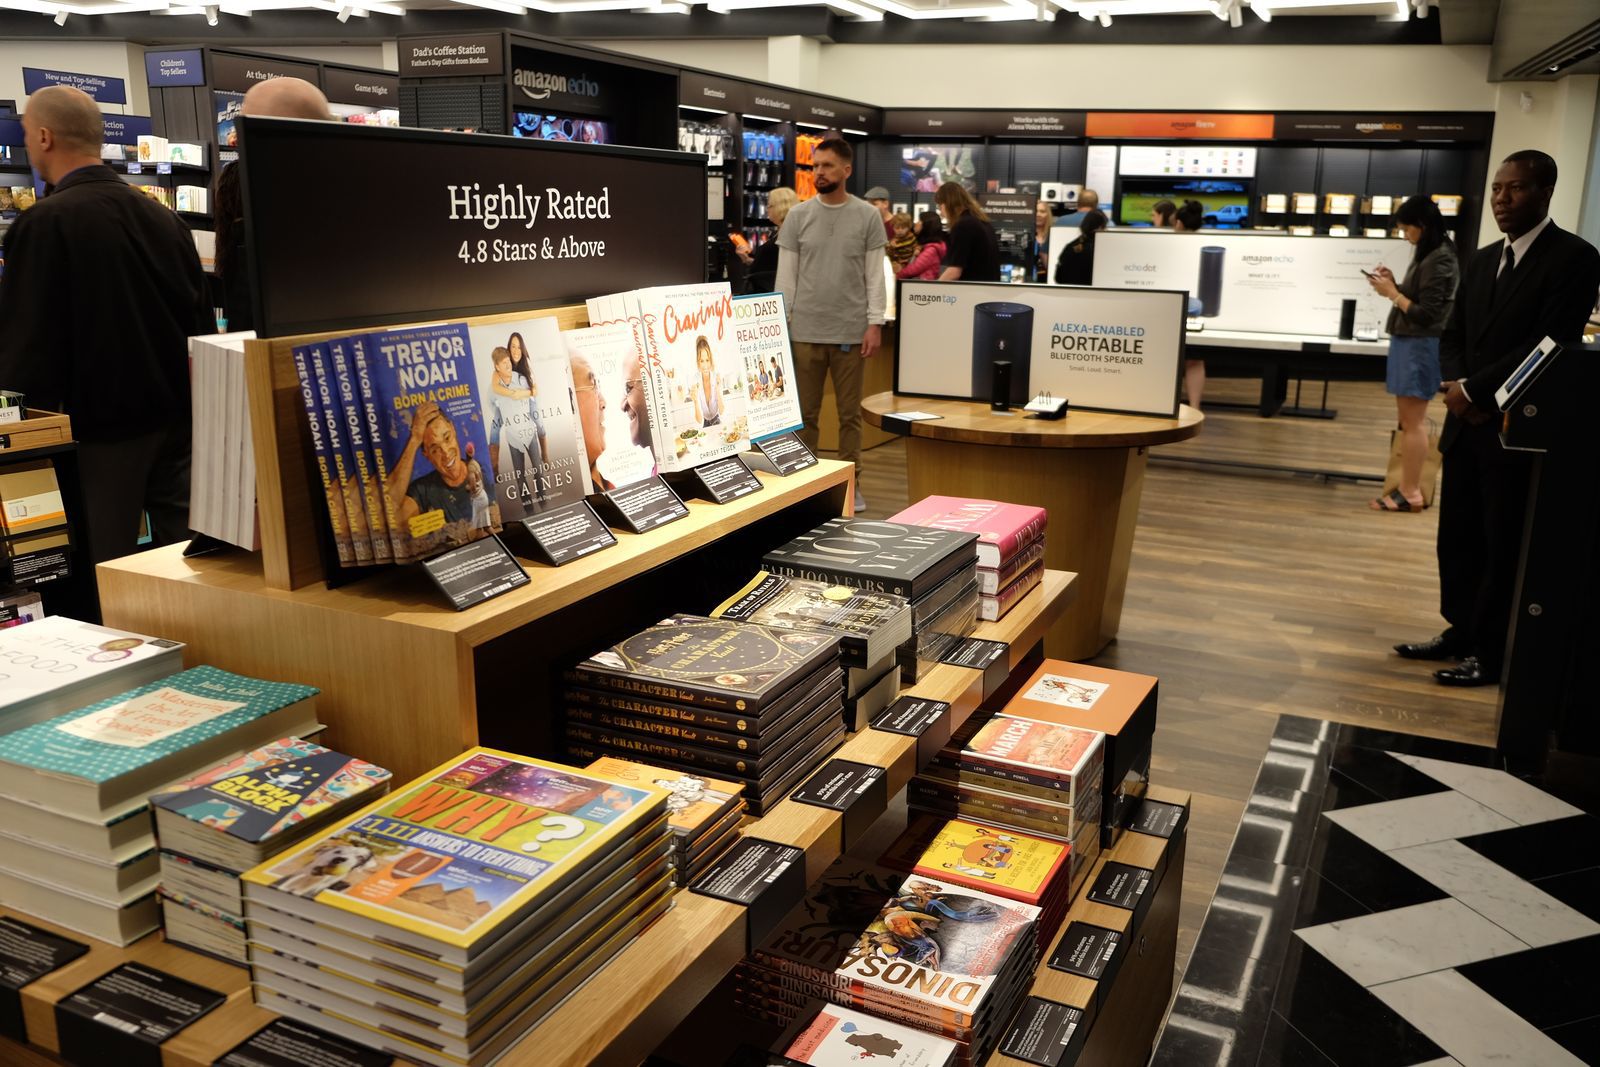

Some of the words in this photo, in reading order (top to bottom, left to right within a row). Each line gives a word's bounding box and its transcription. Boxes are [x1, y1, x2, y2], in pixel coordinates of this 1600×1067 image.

[413, 48, 432, 57] Dad's
[434, 46, 456, 56] Coffee
[458, 44, 486, 54] Station
[160, 68, 170, 76] Top
[432, 58, 442, 68] Day
[442, 58, 454, 66] Gifts
[72, 76, 106, 87] Top-Selling
[246, 70, 254, 78] At
[256, 71, 266, 80] the
[514, 68, 566, 95] amazon
[568, 73, 599, 97] echo
[354, 84, 370, 92] Game
[372, 86, 388, 96] Night
[448, 182, 541, 230] Highly
[546, 187, 611, 220] Rated
[458, 240, 488, 264] 4.8
[493, 238, 536, 262] Stars
[541, 237, 554, 259] &
[558, 234, 606, 258] Above
[1242, 255, 1272, 264] amazon
[1273, 254, 1294, 263] echo
[1124, 264, 1142, 272] echo
[1142, 264, 1156, 272] dot
[734, 304, 752, 319] 100
[754, 300, 778, 317] DAYS
[909, 294, 941, 304] amazon
[942, 294, 956, 305] tap
[664, 294, 732, 343] Cravings
[1052, 323, 1145, 336] ALEXA-ENABLED
[736, 328, 758, 342] REAL
[760, 324, 781, 338] FOOD
[1050, 334, 1144, 354] PORTABLE
[380, 336, 466, 368] TREVOR
[643, 314, 666, 372] Cravings
[656, 370, 665, 400] CHRISSY
[740, 344, 752, 354] fast
[759, 340, 782, 351] fabulous
[600, 359, 616, 376] JOY
[1050, 352, 1102, 362] BLUETOOTH
[1104, 354, 1143, 365] SPEAKER
[400, 360, 458, 390] NOAH
[641, 371, 650, 401] CHRISSY
[393, 392, 426, 410] BORN
[428, 390, 436, 402] A
[438, 384, 470, 402] CRIME
[492, 406, 562, 429] MAGNOLIA
[296, 352, 314, 408] TREVOR
[308, 412, 324, 450] NOAH
[318, 456, 330, 488] BORN
[328, 500, 341, 534] CRIME
[312, 349, 331, 406] TREVOR
[325, 410, 341, 448] NOAH
[334, 454, 348, 486] BORN
[344, 498, 358, 532] CRIME
[332, 346, 353, 402] TREVOR
[346, 406, 362, 445] NOAH
[356, 451, 369, 484] BORN
[366, 496, 380, 530] CRIME
[354, 340, 372, 398] TREVOR
[366, 404, 381, 443] NOAH
[374, 448, 388, 482] BORN
[384, 494, 397, 529] CRIME
[700, 449, 718, 460] CHRISSY
[720, 444, 736, 454] TEIGEN
[496, 469, 521, 484] CHIP
[524, 466, 538, 476] AND
[540, 457, 574, 473] JOANNA
[506, 470, 572, 500] GAINES
[792, 522, 909, 564] 100
[860, 528, 951, 570] YEARS
[761, 564, 795, 578] FAIR
[836, 576, 884, 593] YEARS
[3, 650, 78, 672] FOOD
[709, 645, 737, 658] Vault
[192, 681, 226, 692] Julia
[226, 688, 264, 696] Child
[610, 679, 678, 698] CHARACTER
[679, 690, 695, 700] Vault
[154, 692, 230, 712] Mastering
[612, 699, 678, 718] CHARACTER
[680, 710, 696, 721] Vault
[136, 714, 188, 728] French
[177, 709, 200, 718] Art
[614, 717, 680, 736] CHARACTER
[681, 729, 697, 740] Vault
[986, 719, 1033, 758] MARCH
[613, 737, 678, 758] CHARACTER
[210, 782, 290, 812] BLOCK
[226, 774, 302, 805] ALPHA
[392, 784, 585, 852] WHY?
[364, 818, 422, 840] 1,111
[408, 831, 468, 854] ANSWERS
[458, 843, 478, 858] TO
[473, 848, 548, 876] EVERYTHING
[781, 959, 853, 991] DINOSAUR!
[780, 974, 853, 1008] DINOSAUR!
[906, 1016, 944, 1031] CREATURES
[800, 1040, 816, 1051] best
